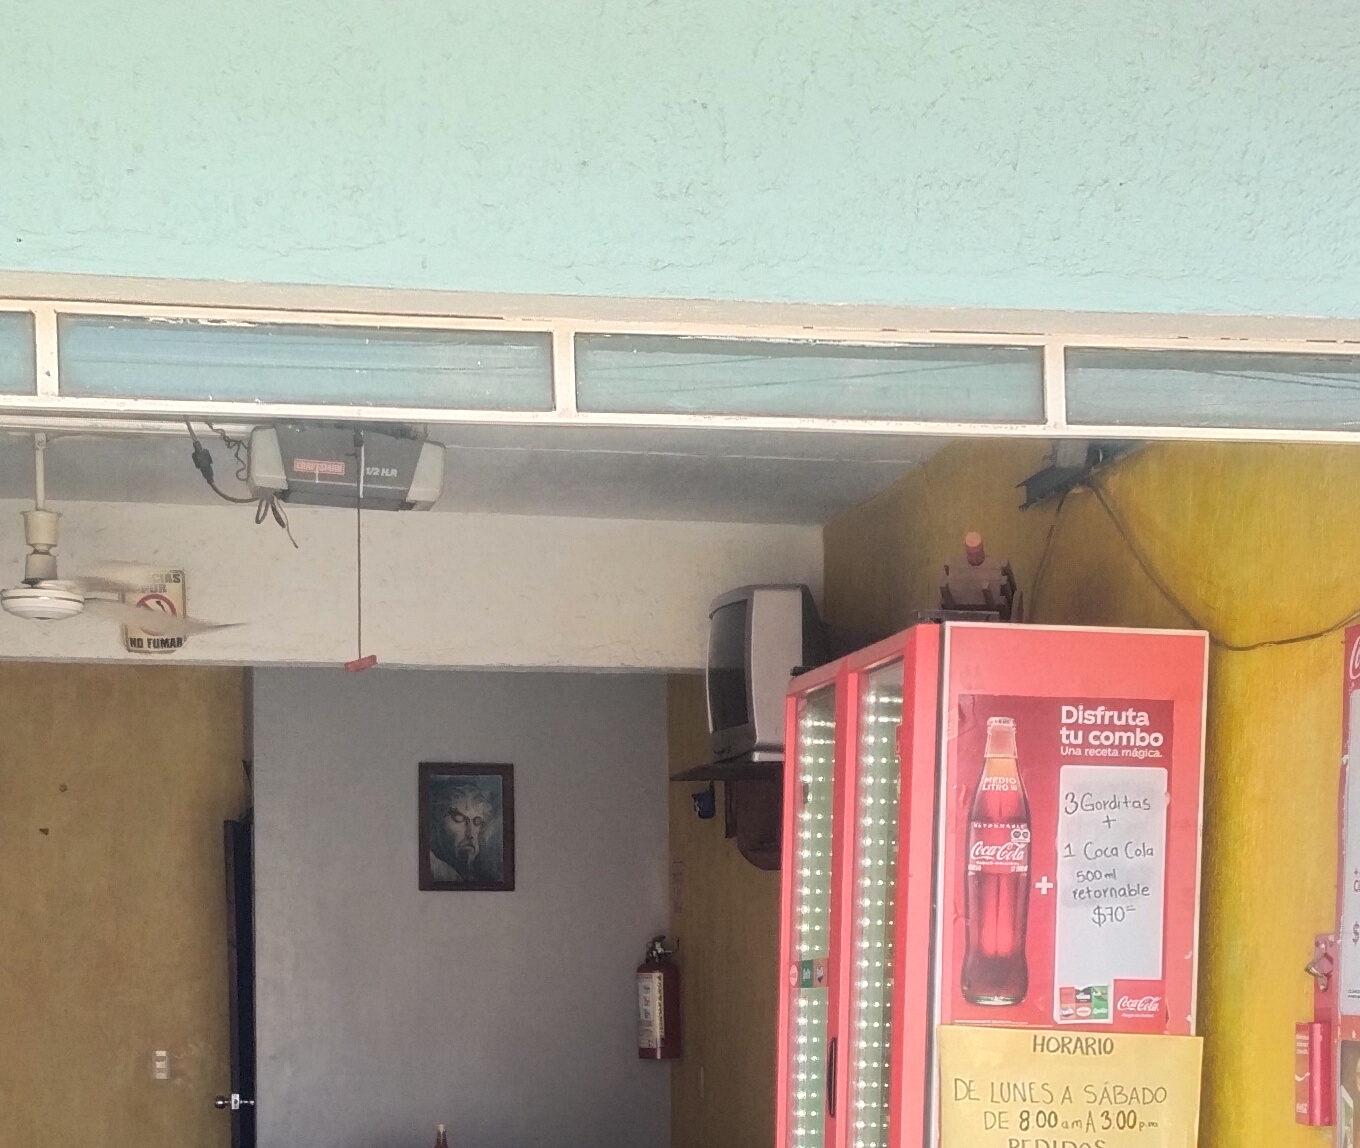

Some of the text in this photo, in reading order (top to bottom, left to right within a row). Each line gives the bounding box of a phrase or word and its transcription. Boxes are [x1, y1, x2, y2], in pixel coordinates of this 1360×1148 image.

[129, 637, 144, 648] NO
[1061, 705, 1149, 726] Disfruta
[1059, 726, 1164, 746] tu combo
[1060, 746, 1082, 756] Una
[1084, 748, 1120, 757] receta
[1064, 792, 1151, 815] 3 Gorditas
[970, 841, 1027, 860] Coca-Cola
[1063, 841, 1154, 860] 1 Coca Cola
[1076, 868, 1117, 883] 500 ml
[1072, 883, 1151, 900] retornable
[1033, 1035, 1114, 1056] HORARIO
[954, 1078, 1167, 1105] DE LUNES A SÁBADO
[983, 1111, 1009, 1130] DE
[1086, 1110, 1096, 1133] A
